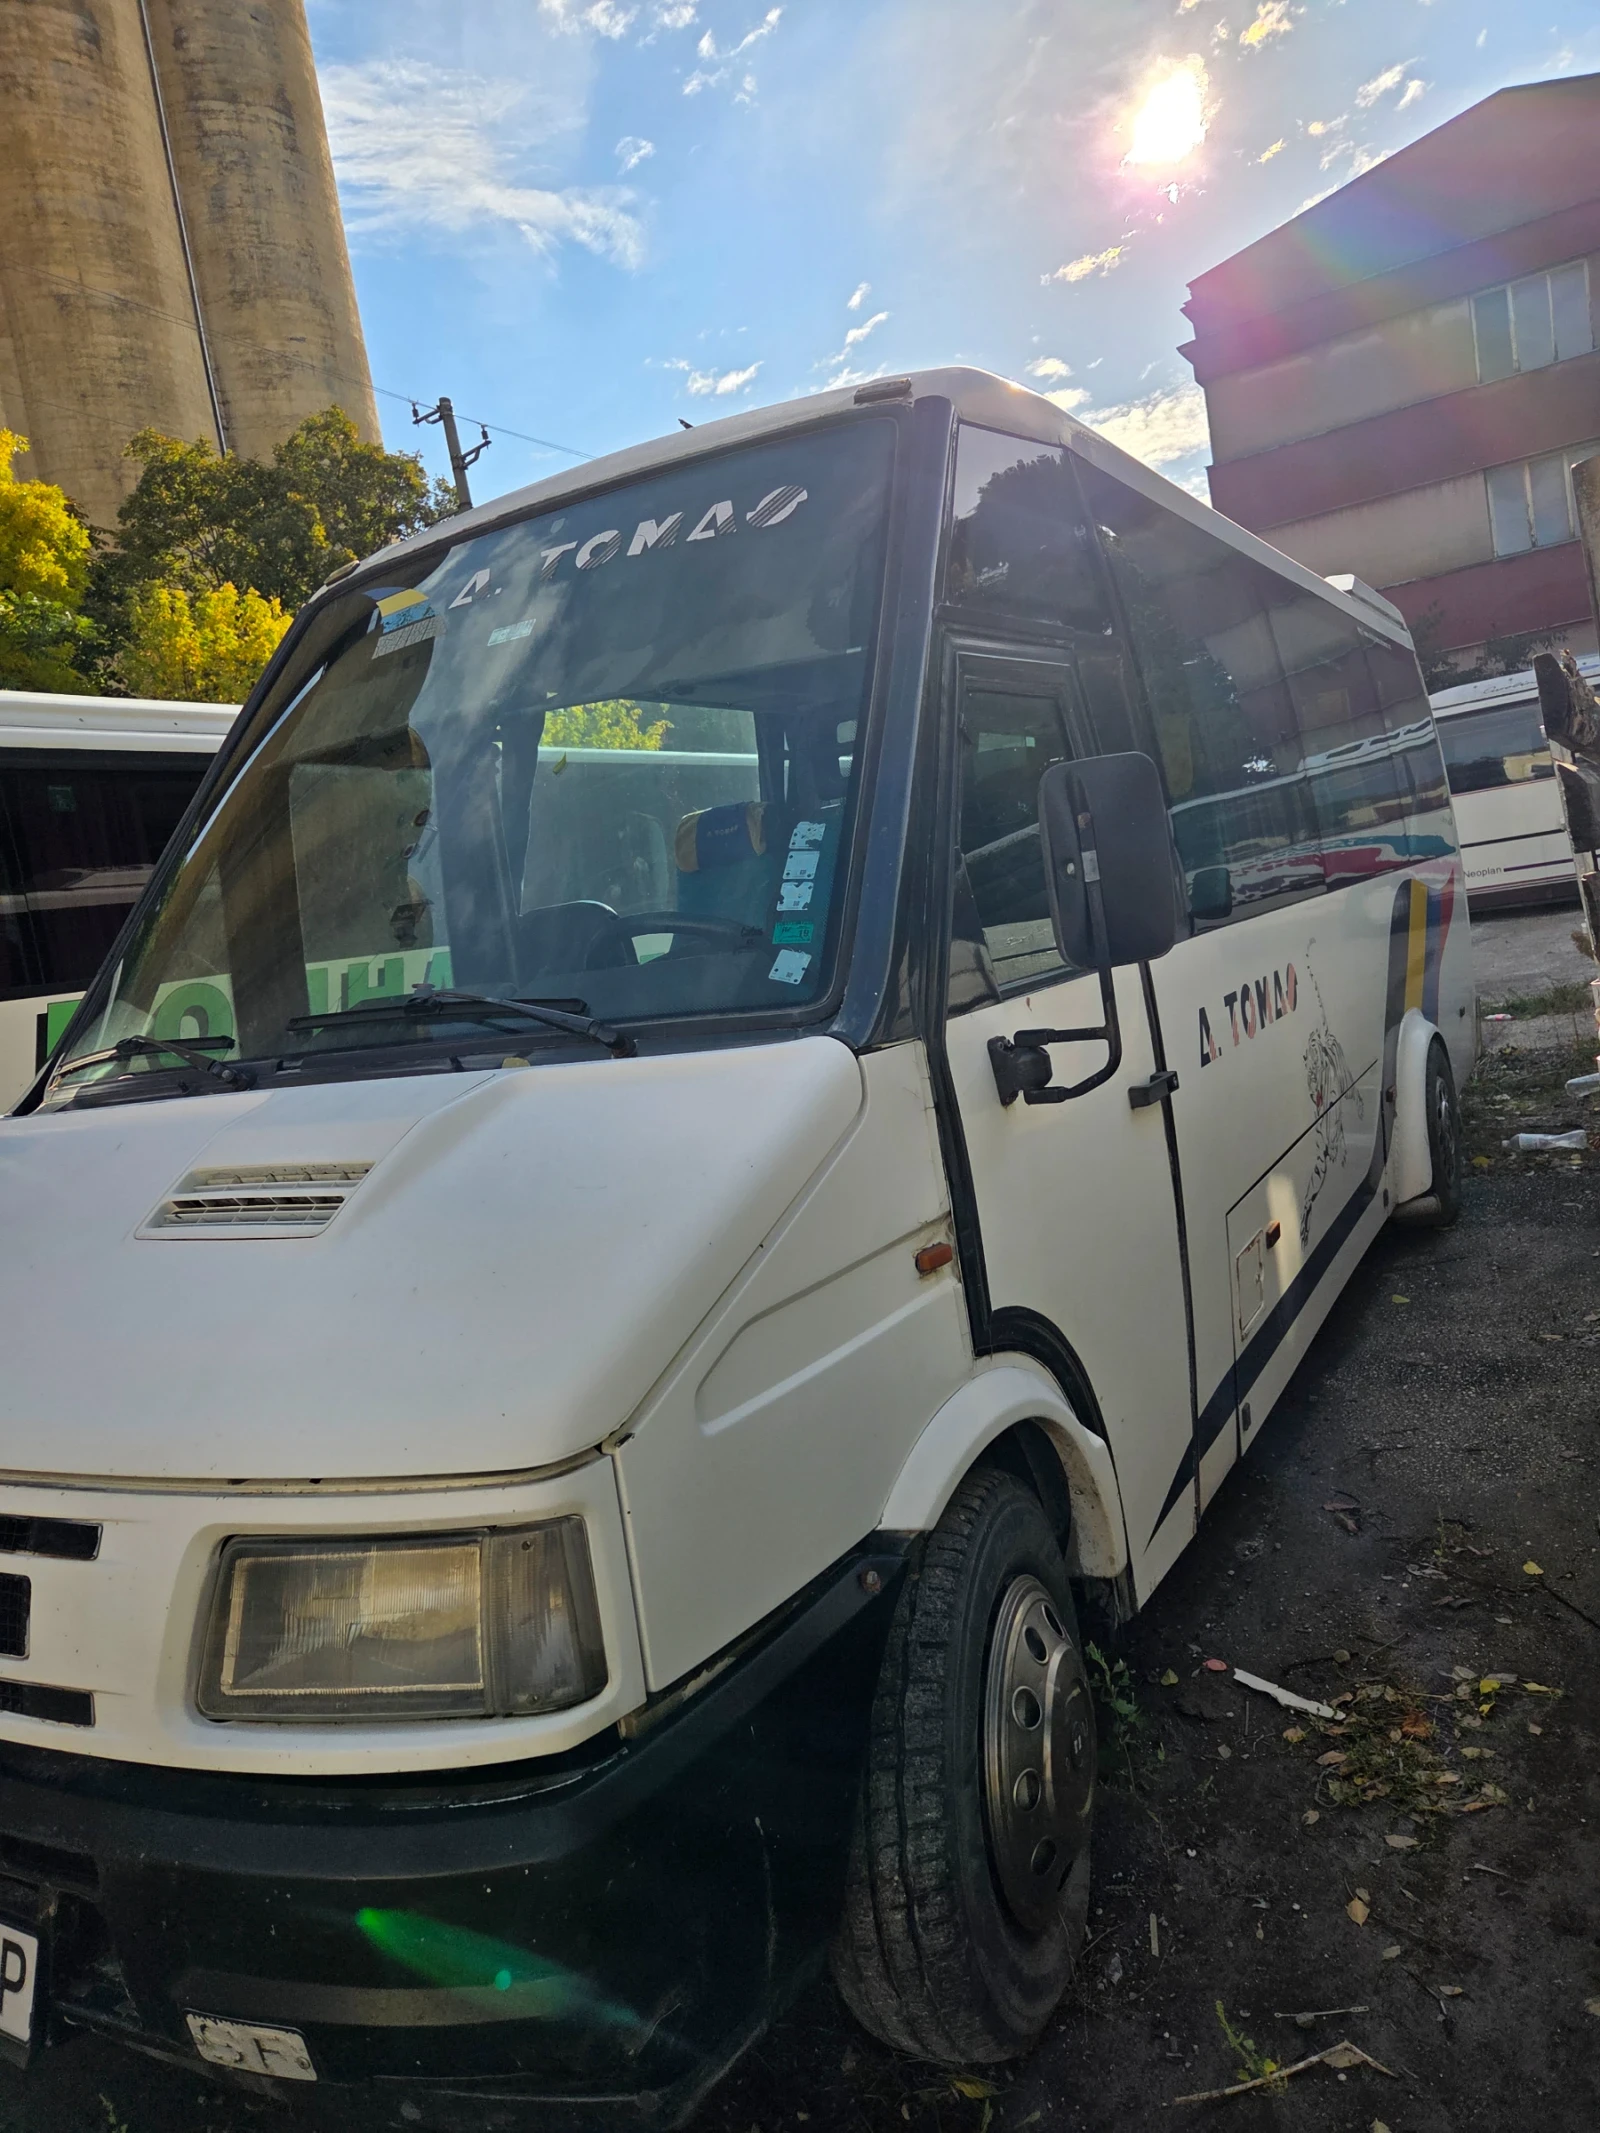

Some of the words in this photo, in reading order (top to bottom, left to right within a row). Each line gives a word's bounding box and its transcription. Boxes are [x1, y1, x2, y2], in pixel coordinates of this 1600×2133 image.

[448, 568, 502, 610] A.
[540, 485, 808, 580] TOMAS
[1463, 867, 1502, 878] Neoplan
[1199, 1007, 1222, 1068] A.
[1223, 962, 1298, 1047] TOMAS
